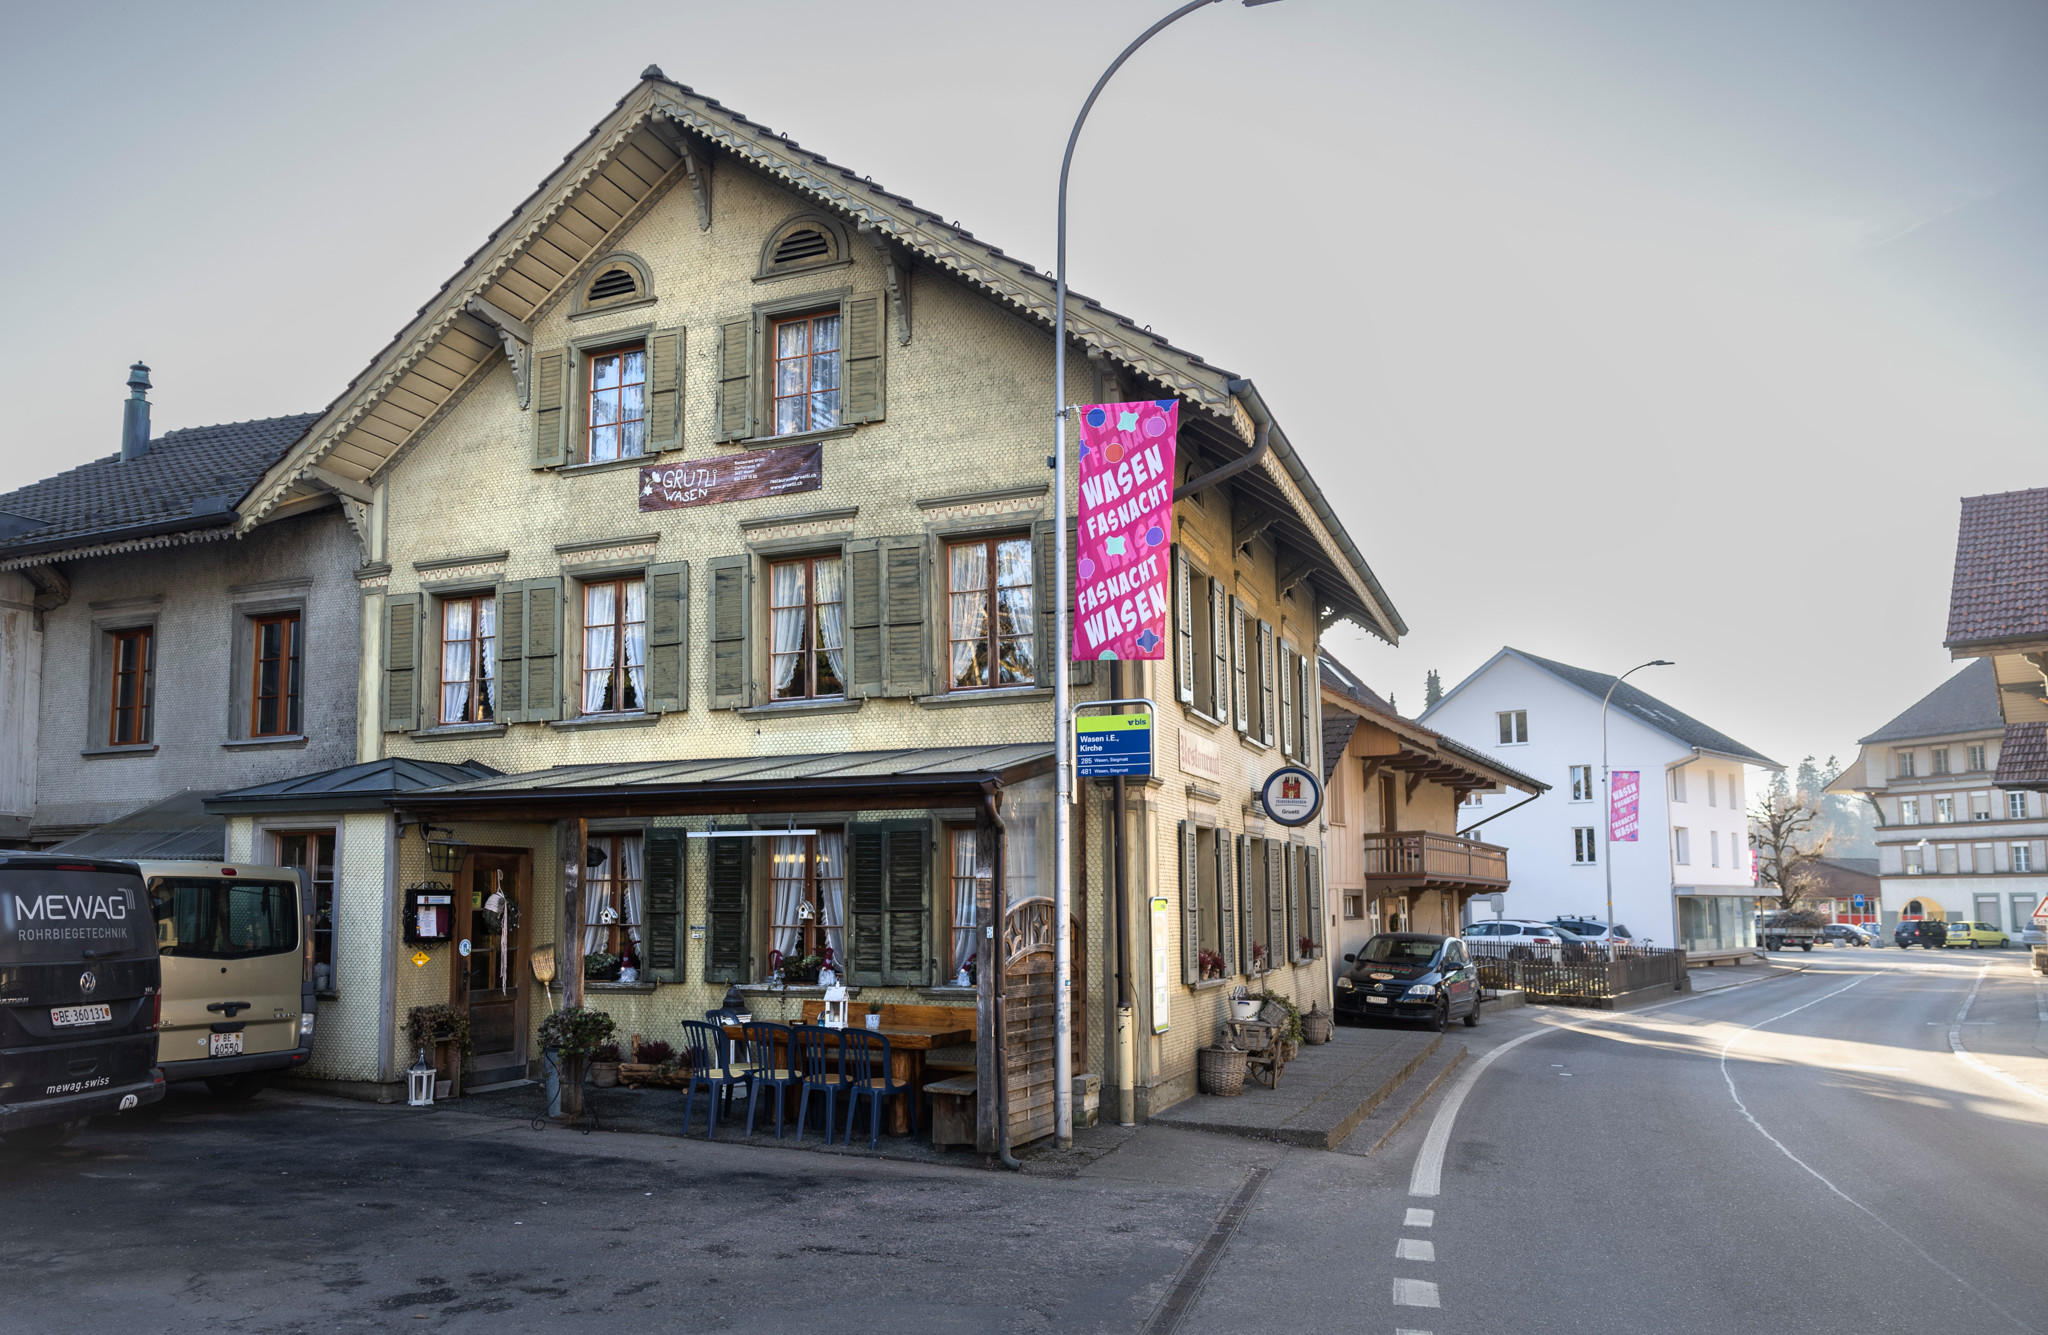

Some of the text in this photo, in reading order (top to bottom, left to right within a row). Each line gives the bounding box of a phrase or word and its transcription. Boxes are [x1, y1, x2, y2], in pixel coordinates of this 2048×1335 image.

[1081, 443, 1164, 511] WASEN
[663, 488, 708, 502] WASEN
[1086, 479, 1168, 540] FASNACHT
[1078, 554, 1159, 616] FASNACHT
[1083, 582, 1167, 650] WASEN
[1134, 718, 1147, 726] bls
[1079, 744, 1103, 752] Kirche
[1080, 735, 1104, 743] Wasen
[1612, 782, 1637, 801] WASEN
[1614, 820, 1639, 839] WASEN
[15, 894, 126, 921] MEWAG
[18, 927, 128, 941] ROHRBIEGETECHNIK
[222, 1033, 232, 1042] BE
[214, 1042, 239, 1054] 60550
[46, 1076, 110, 1095] mewag.swiss
